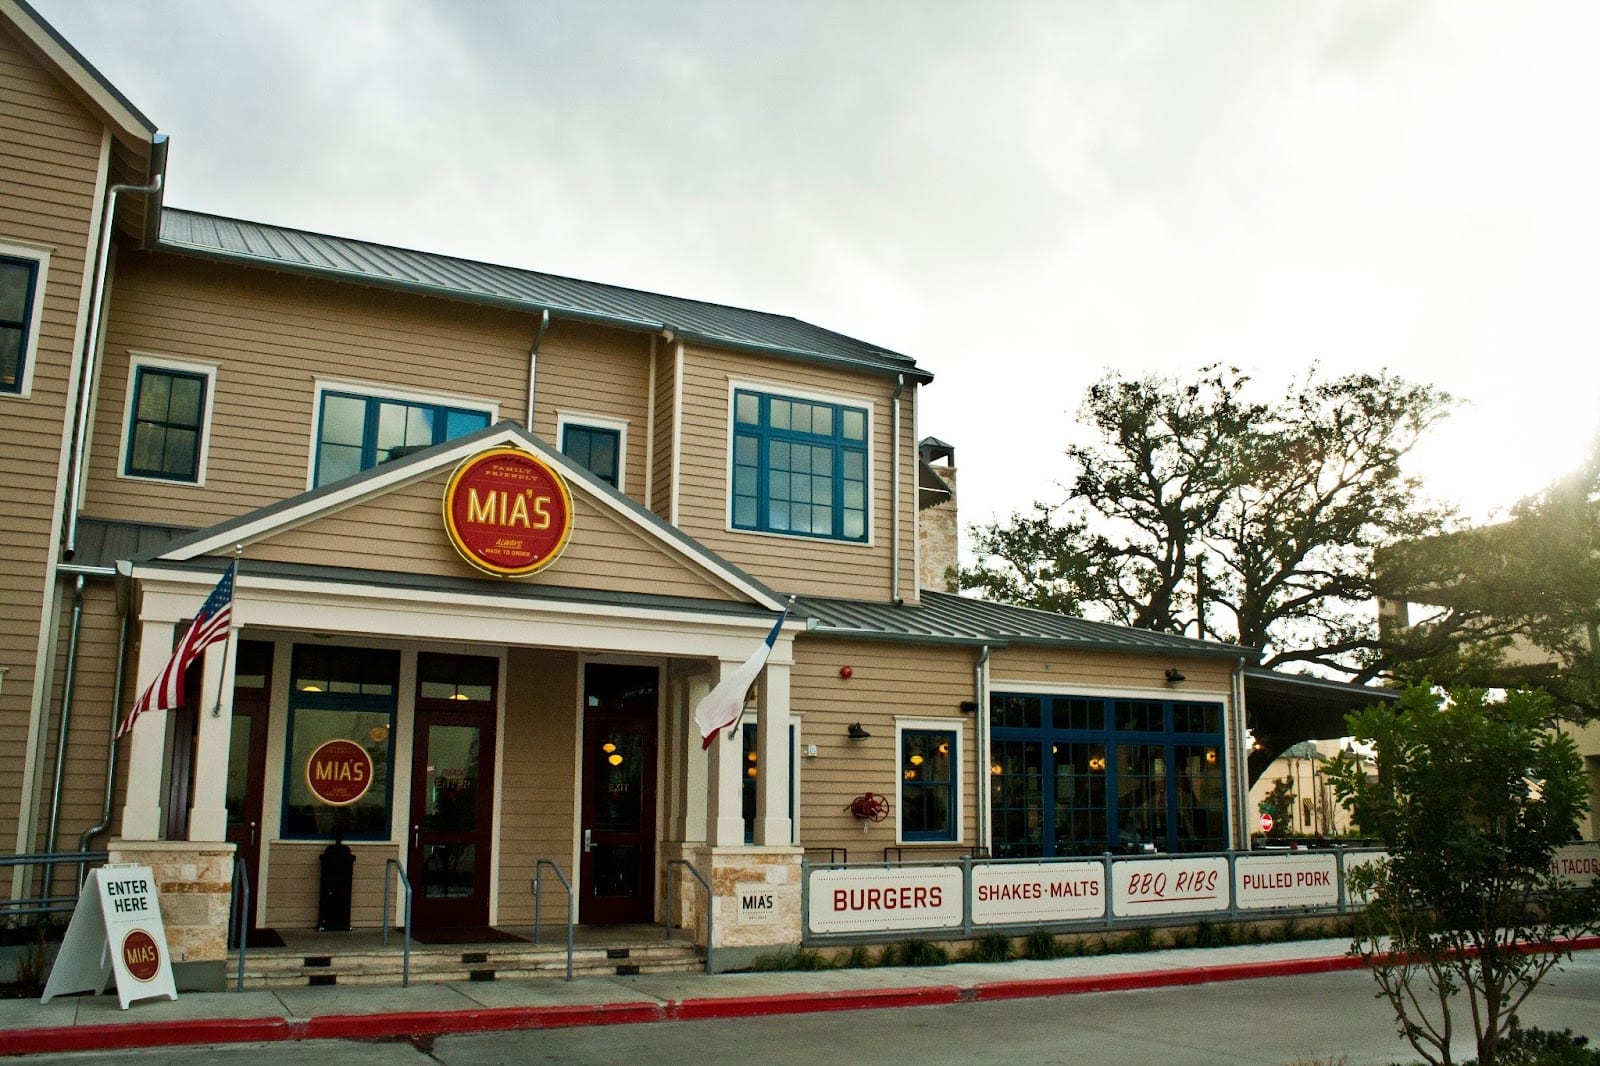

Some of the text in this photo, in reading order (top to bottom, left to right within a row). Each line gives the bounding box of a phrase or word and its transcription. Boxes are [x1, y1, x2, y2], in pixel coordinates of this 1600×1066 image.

[485, 471, 539, 481] FRIENDLY
[492, 464, 532, 474] FAMILY
[467, 487, 551, 530] MIA'S
[511, 550, 531, 558] ORDER
[316, 759, 364, 781] MIA'S
[435, 777, 471, 789] ENTER
[608, 783, 629, 792] EXIT
[1562, 858, 1598, 875] TACOS
[107, 880, 148, 896] ENTER
[1128, 870, 1217, 897] BBQ RIBS
[1243, 871, 1330, 889] PULLED PORK
[834, 886, 942, 911] BURGERS
[978, 880, 1099, 901] SHAKES MALTS
[114, 897, 148, 912] HERE
[743, 894, 773, 909] MIA'S
[127, 944, 156, 964] MIA'S
